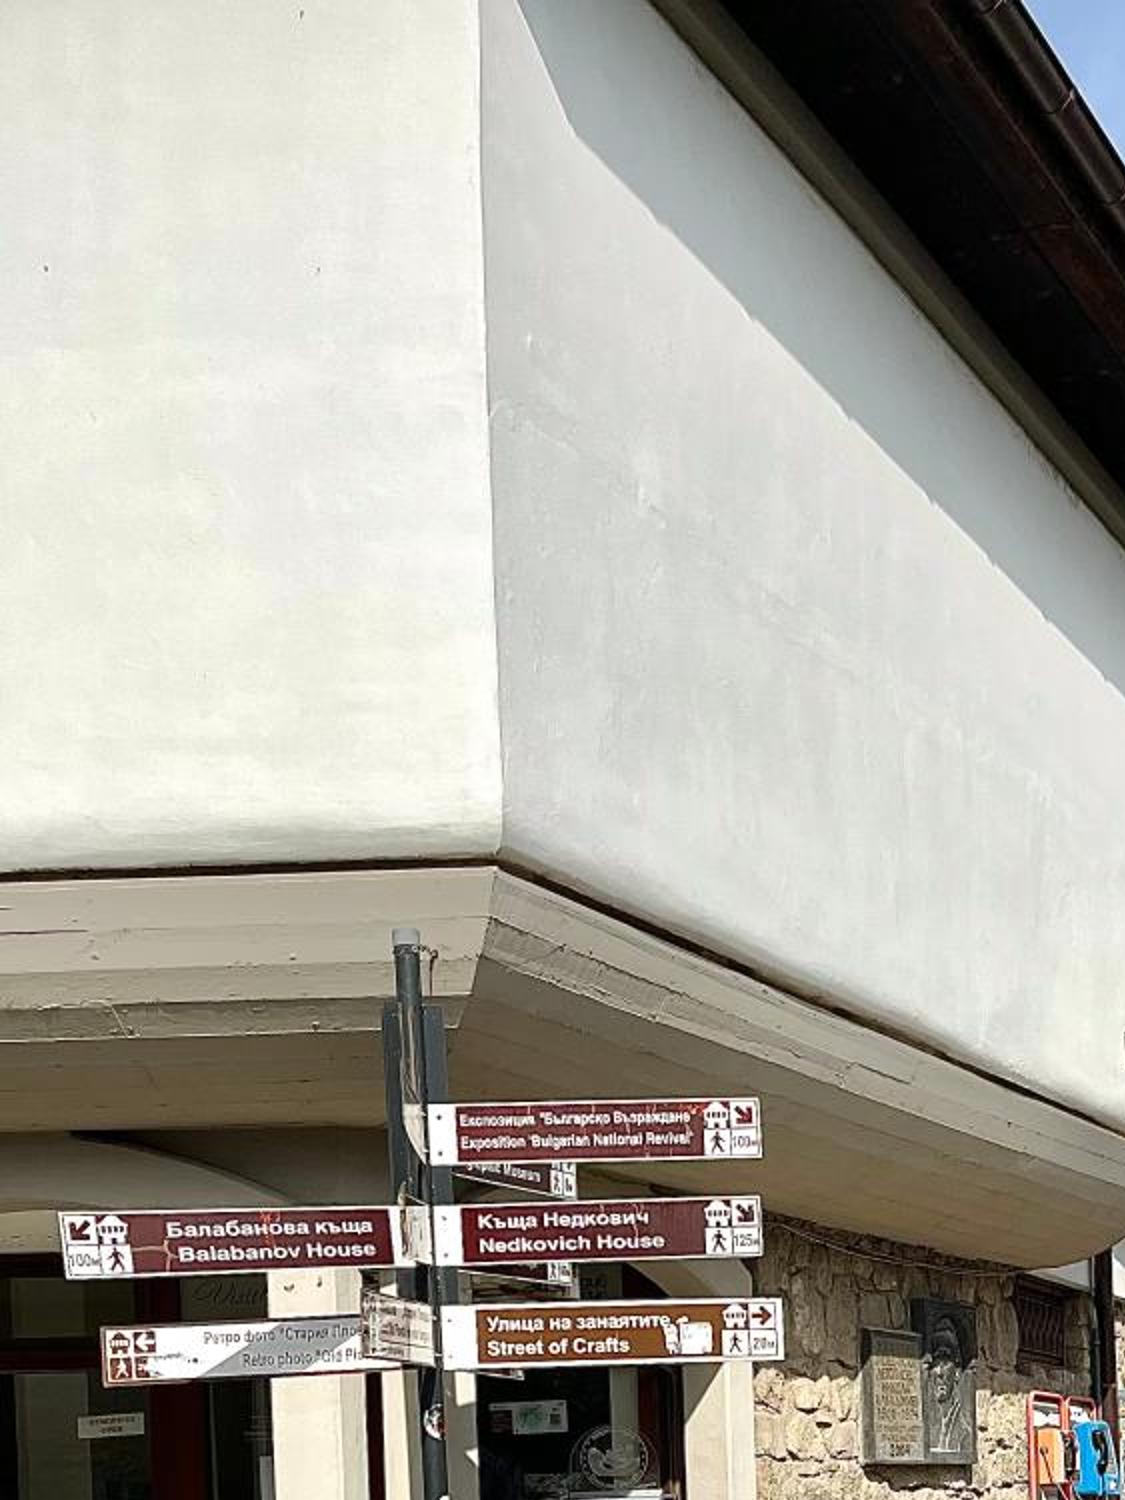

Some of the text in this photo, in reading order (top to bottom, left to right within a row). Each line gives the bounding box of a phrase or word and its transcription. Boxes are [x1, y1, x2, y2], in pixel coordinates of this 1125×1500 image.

[459, 1113, 535, 1127] Експозиция
[460, 1135, 526, 1152] Exposition
[593, 1132, 643, 1146] National
[166, 1219, 374, 1239] Балабанова къща
[477, 1211, 649, 1231] Къща Недкович
[178, 1241, 377, 1263] Balabanov House
[479, 1231, 666, 1253] Nedkovich House
[486, 1315, 671, 1334] Улица на занаятите
[203, 1331, 241, 1345] Ретро
[487, 1337, 630, 1356] Street of Crafts
